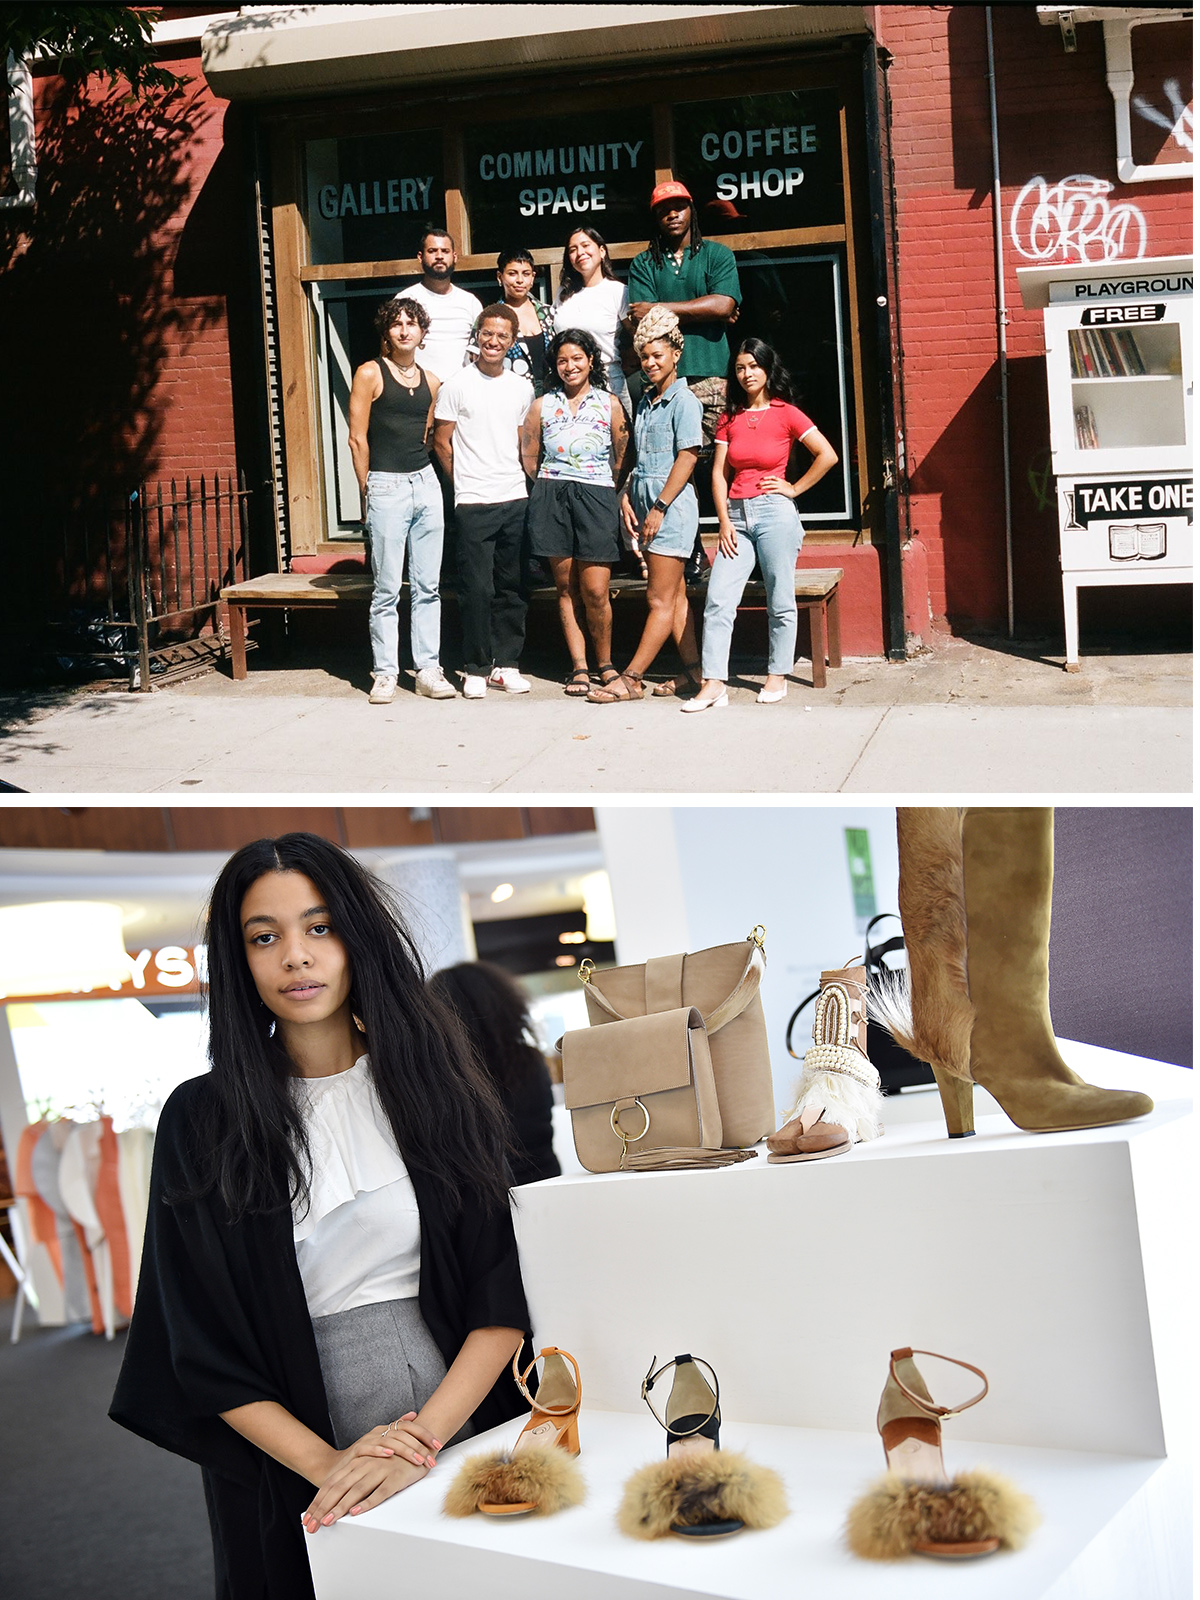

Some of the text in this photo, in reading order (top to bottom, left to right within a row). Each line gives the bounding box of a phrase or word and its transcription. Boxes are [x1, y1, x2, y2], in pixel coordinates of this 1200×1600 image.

[701, 125, 817, 161] COFFEE
[480, 141, 644, 181] COMMUNITY
[319, 176, 434, 219] GALLERY
[519, 183, 607, 216] SPACE
[716, 167, 804, 200] SHOP
[1090, 306, 1156, 323] FREE
[1079, 484, 1193, 513] TAKE ONE
